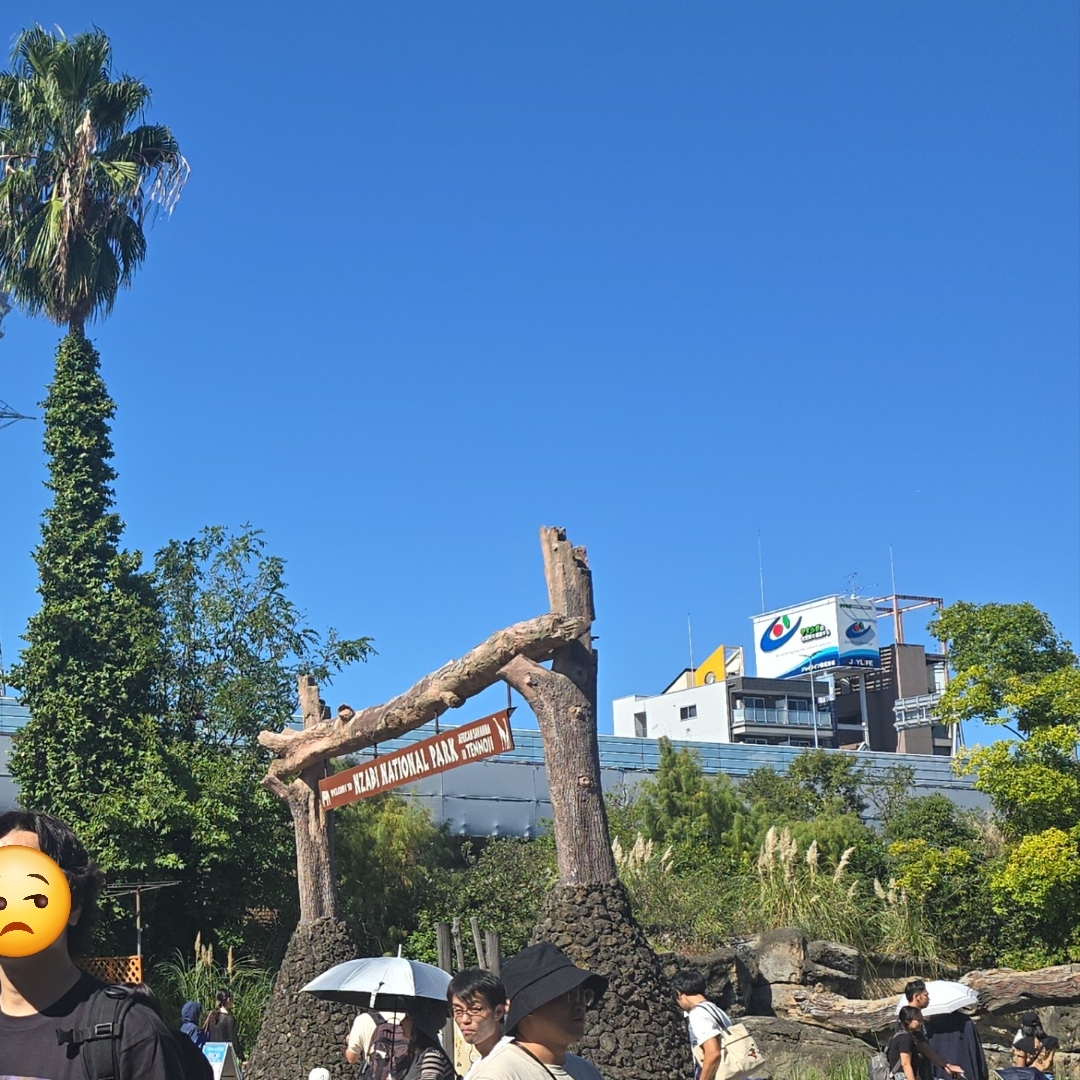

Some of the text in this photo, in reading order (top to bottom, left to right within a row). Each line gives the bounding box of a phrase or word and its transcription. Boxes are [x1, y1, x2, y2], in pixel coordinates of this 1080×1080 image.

[352, 765, 380, 796] NZABI
[380, 748, 430, 786] NATIONAL
[428, 737, 459, 769] PARK
[465, 735, 495, 759] TENNOJI
